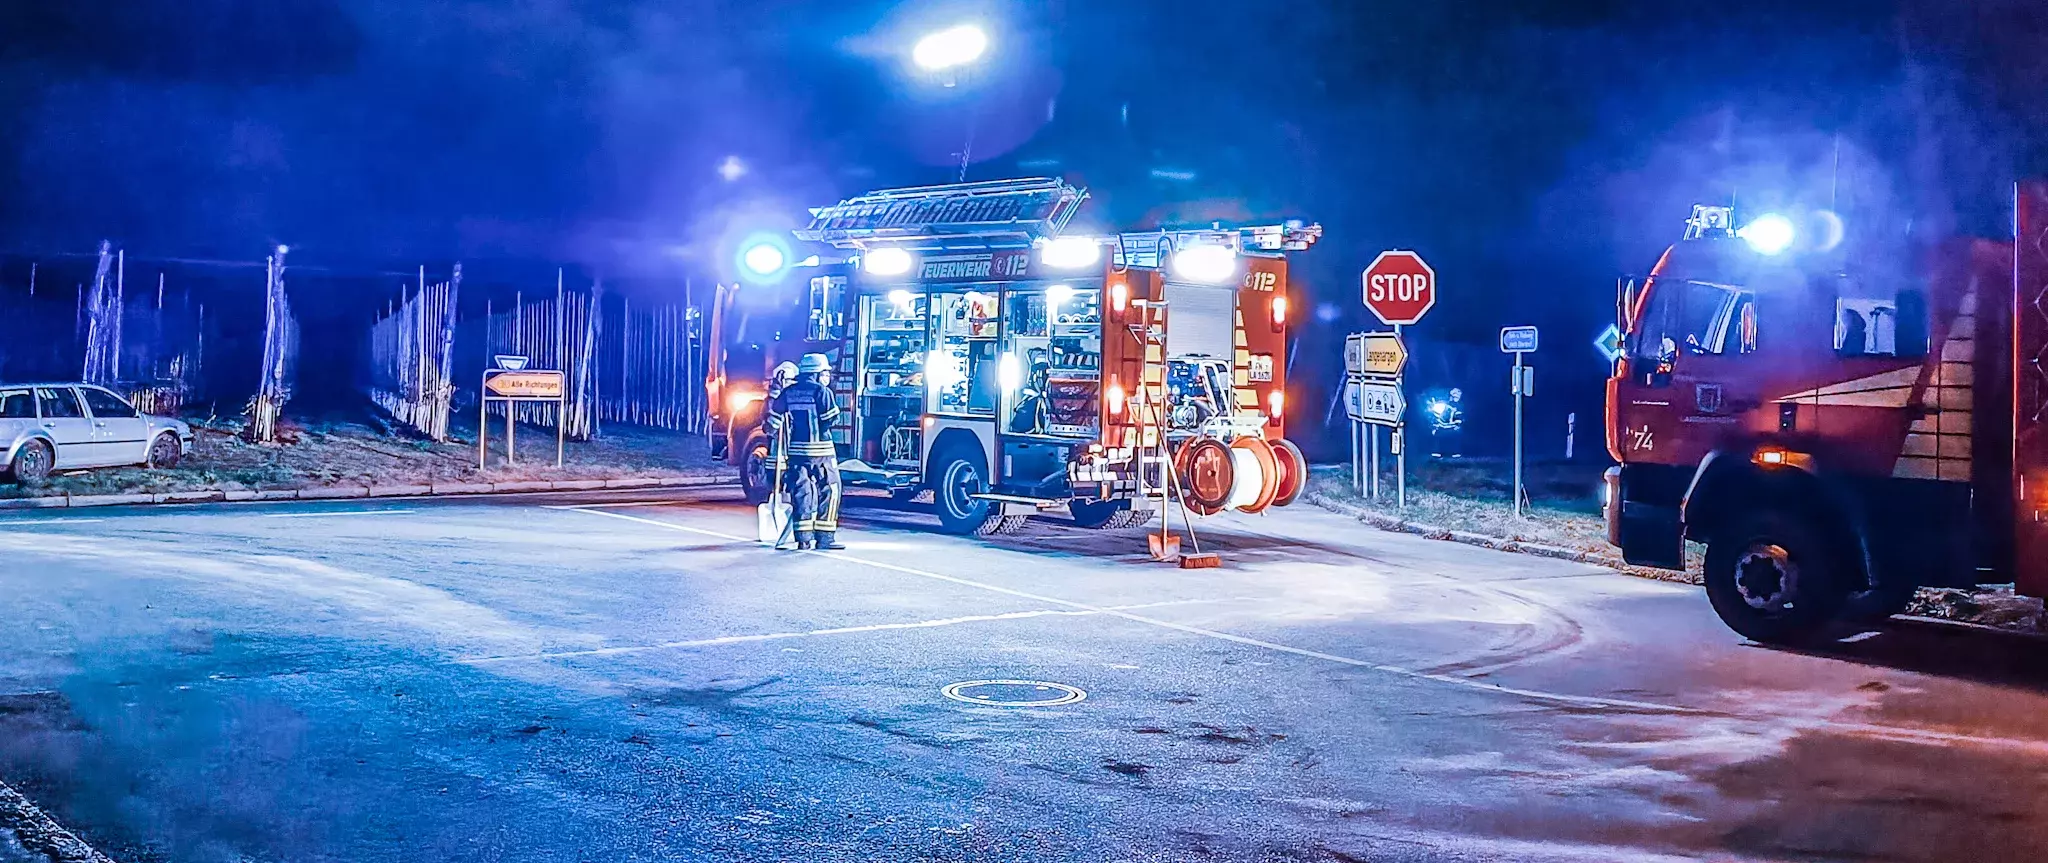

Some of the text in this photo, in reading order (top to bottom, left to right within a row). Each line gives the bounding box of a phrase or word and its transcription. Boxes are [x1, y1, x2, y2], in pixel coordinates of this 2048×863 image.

[917, 254, 1029, 278] FEUERWEHR 112
[1253, 271, 1276, 292] 112
[1370, 273, 1427, 302] STOP
[511, 380, 558, 391] Alle Richtungen
[1634, 431, 1654, 451] 74
